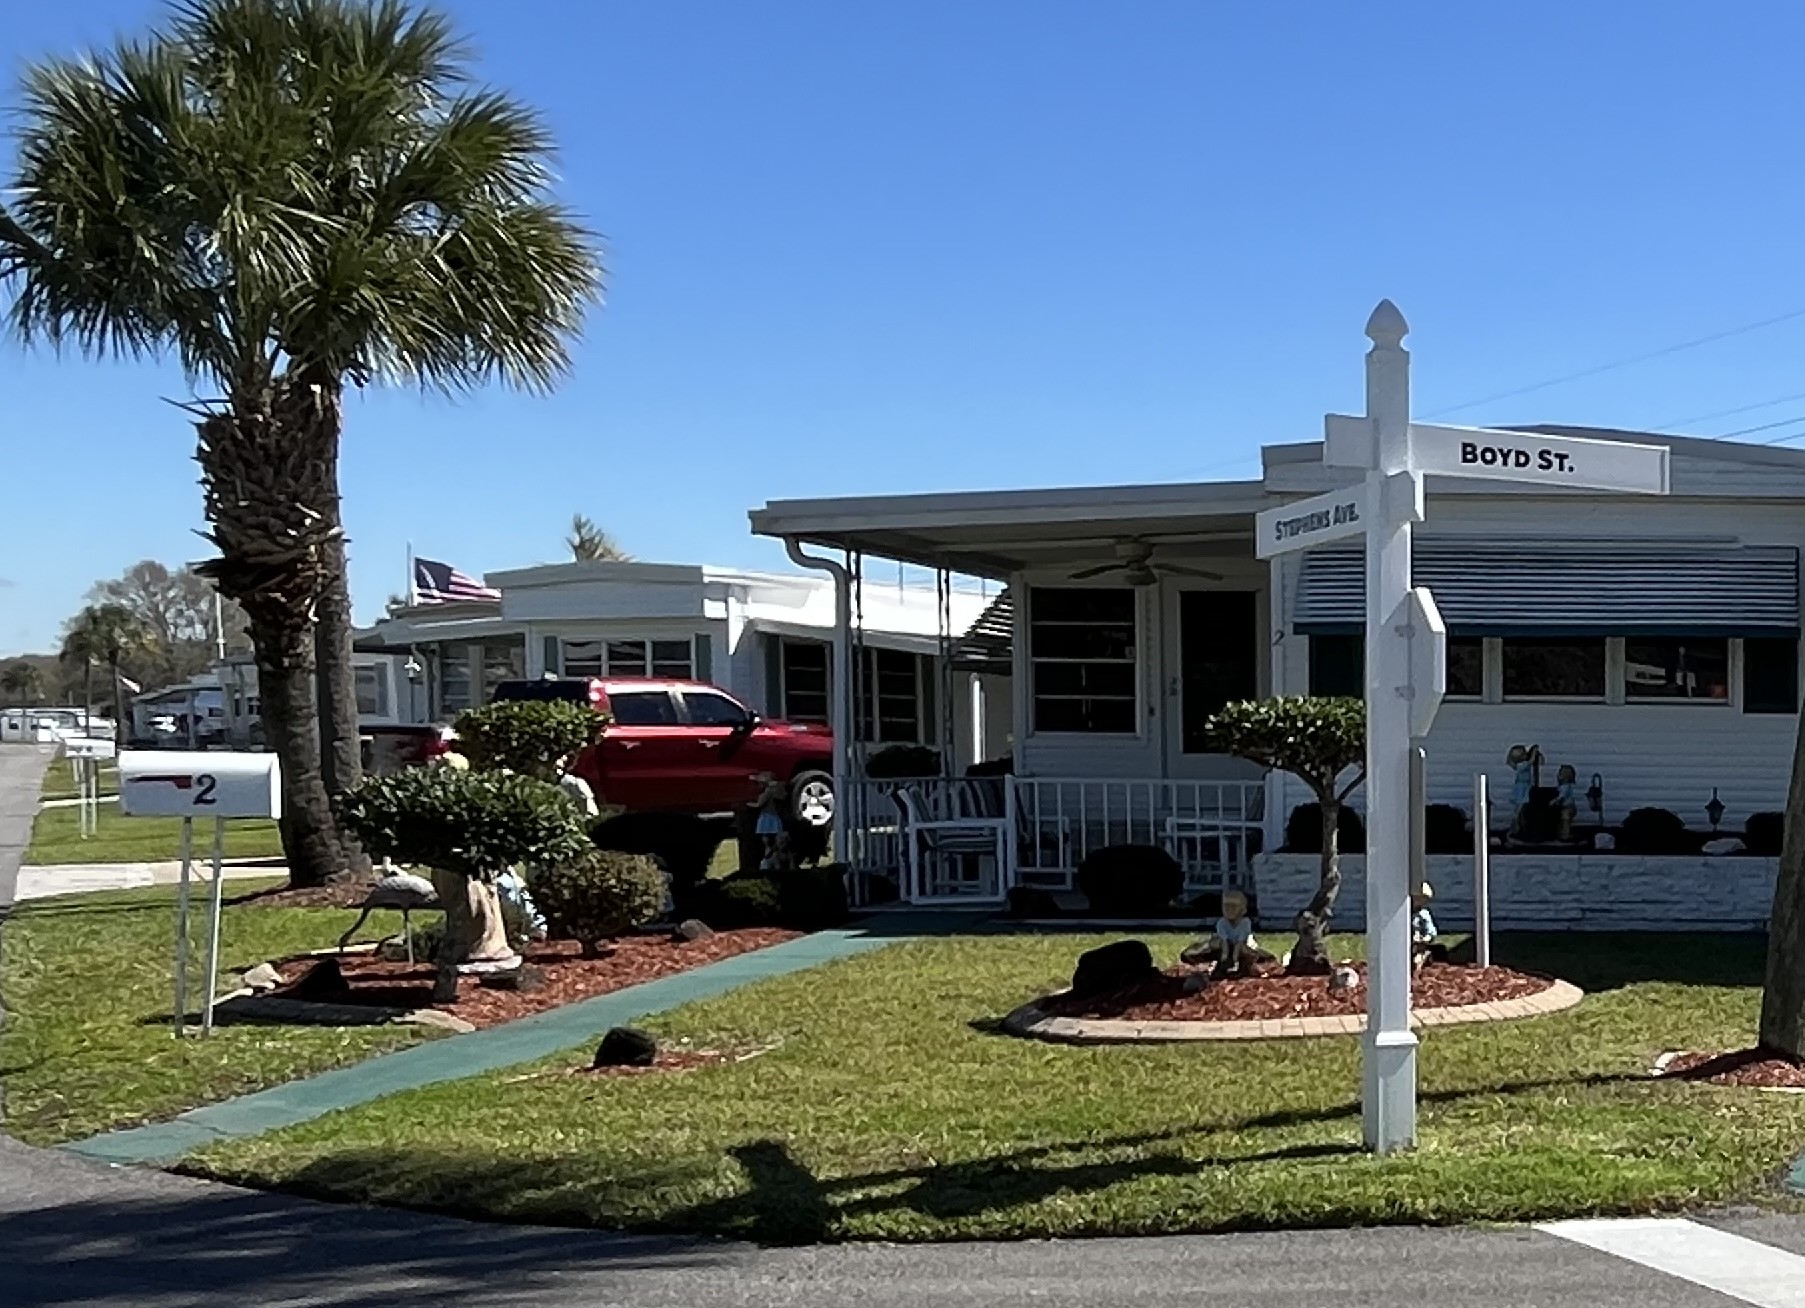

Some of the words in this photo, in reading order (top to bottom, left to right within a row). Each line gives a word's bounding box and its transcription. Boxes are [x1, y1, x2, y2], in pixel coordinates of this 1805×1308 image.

[1461, 442, 1531, 468] BOYD
[1537, 448, 1575, 472] ST.
[1332, 503, 1360, 528] AVE.
[1272, 629, 1286, 646] 2
[193, 773, 217, 805] 2
